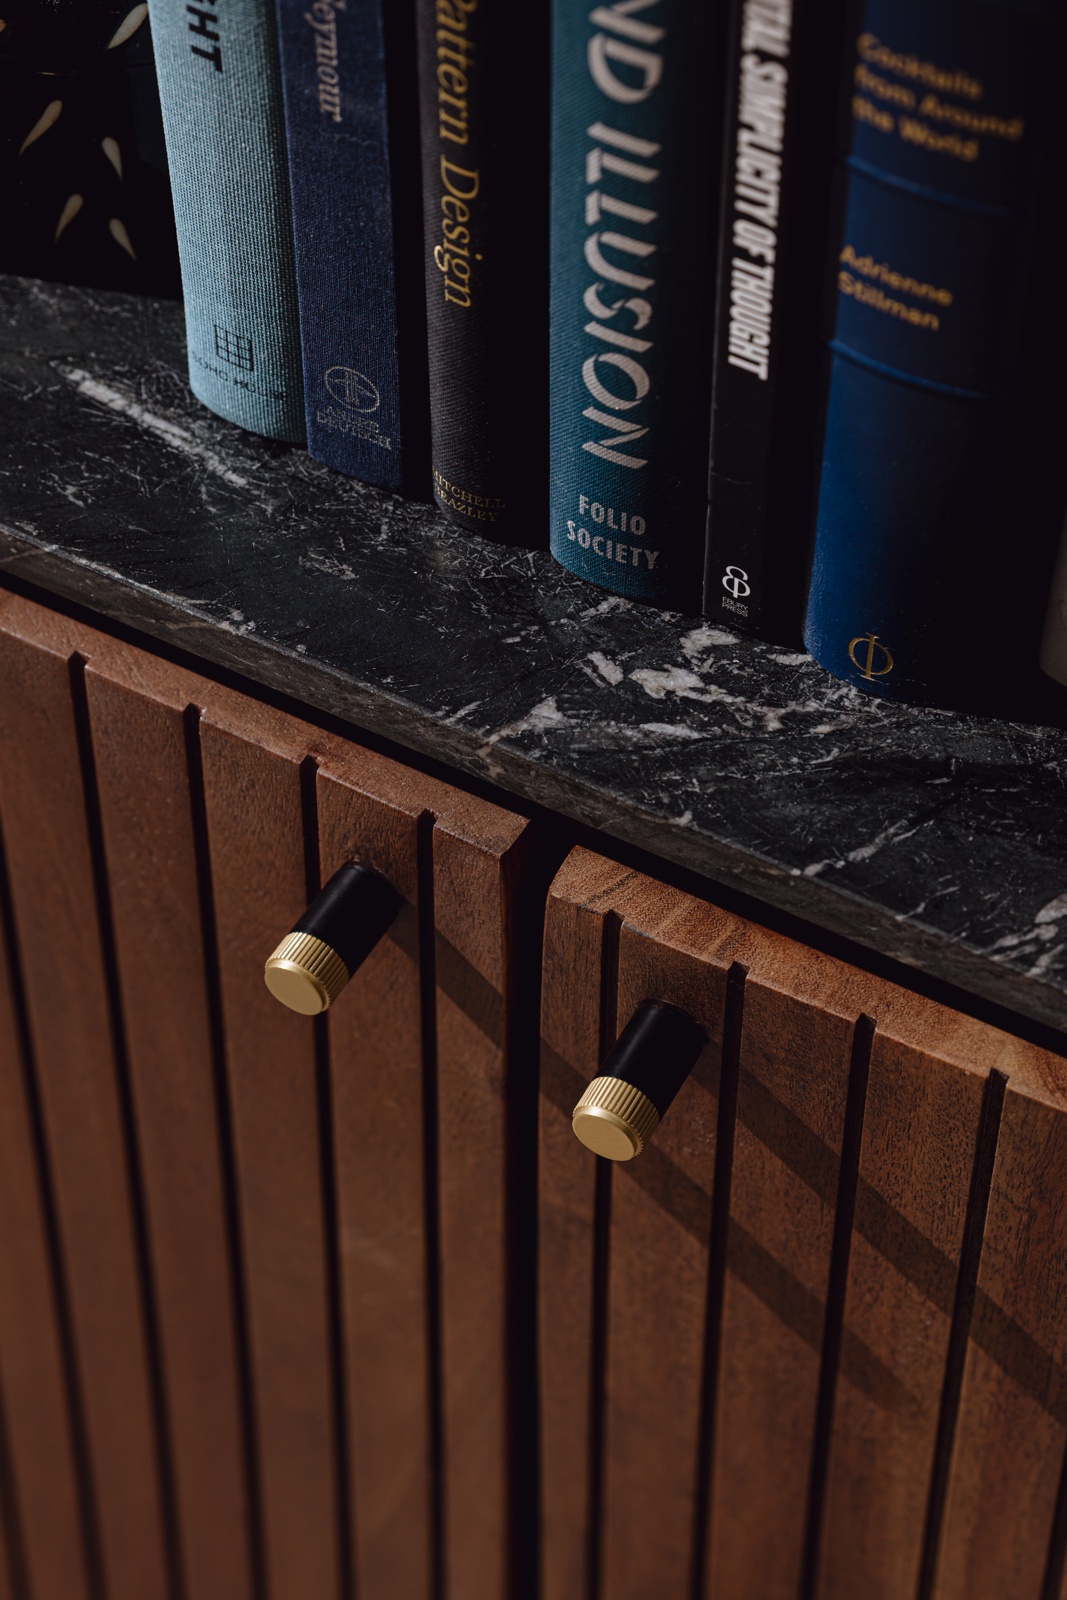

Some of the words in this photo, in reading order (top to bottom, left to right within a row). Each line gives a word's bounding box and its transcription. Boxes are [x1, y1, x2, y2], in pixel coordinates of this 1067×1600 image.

[186, 0, 223, 73] HT
[303, 0, 348, 123] eymour
[856, 31, 984, 102] Cocktails
[852, 94, 896, 135] the
[898, 115, 980, 163] World
[854, 62, 917, 112] from
[918, 93, 1025, 142] Around
[733, 52, 789, 230] SIMPLICITY
[434, 153, 483, 308] Design
[731, 218, 778, 265] OF
[581, 121, 662, 472] ILLUSION
[837, 270, 940, 332] Stillman
[838, 244, 954, 308] Adrienne
[727, 256, 775, 382] THOUGHT
[566, 519, 660, 570] SOCIETY
[579, 493, 647, 536] FOLIO
[721, 602, 748, 618] PRESS
